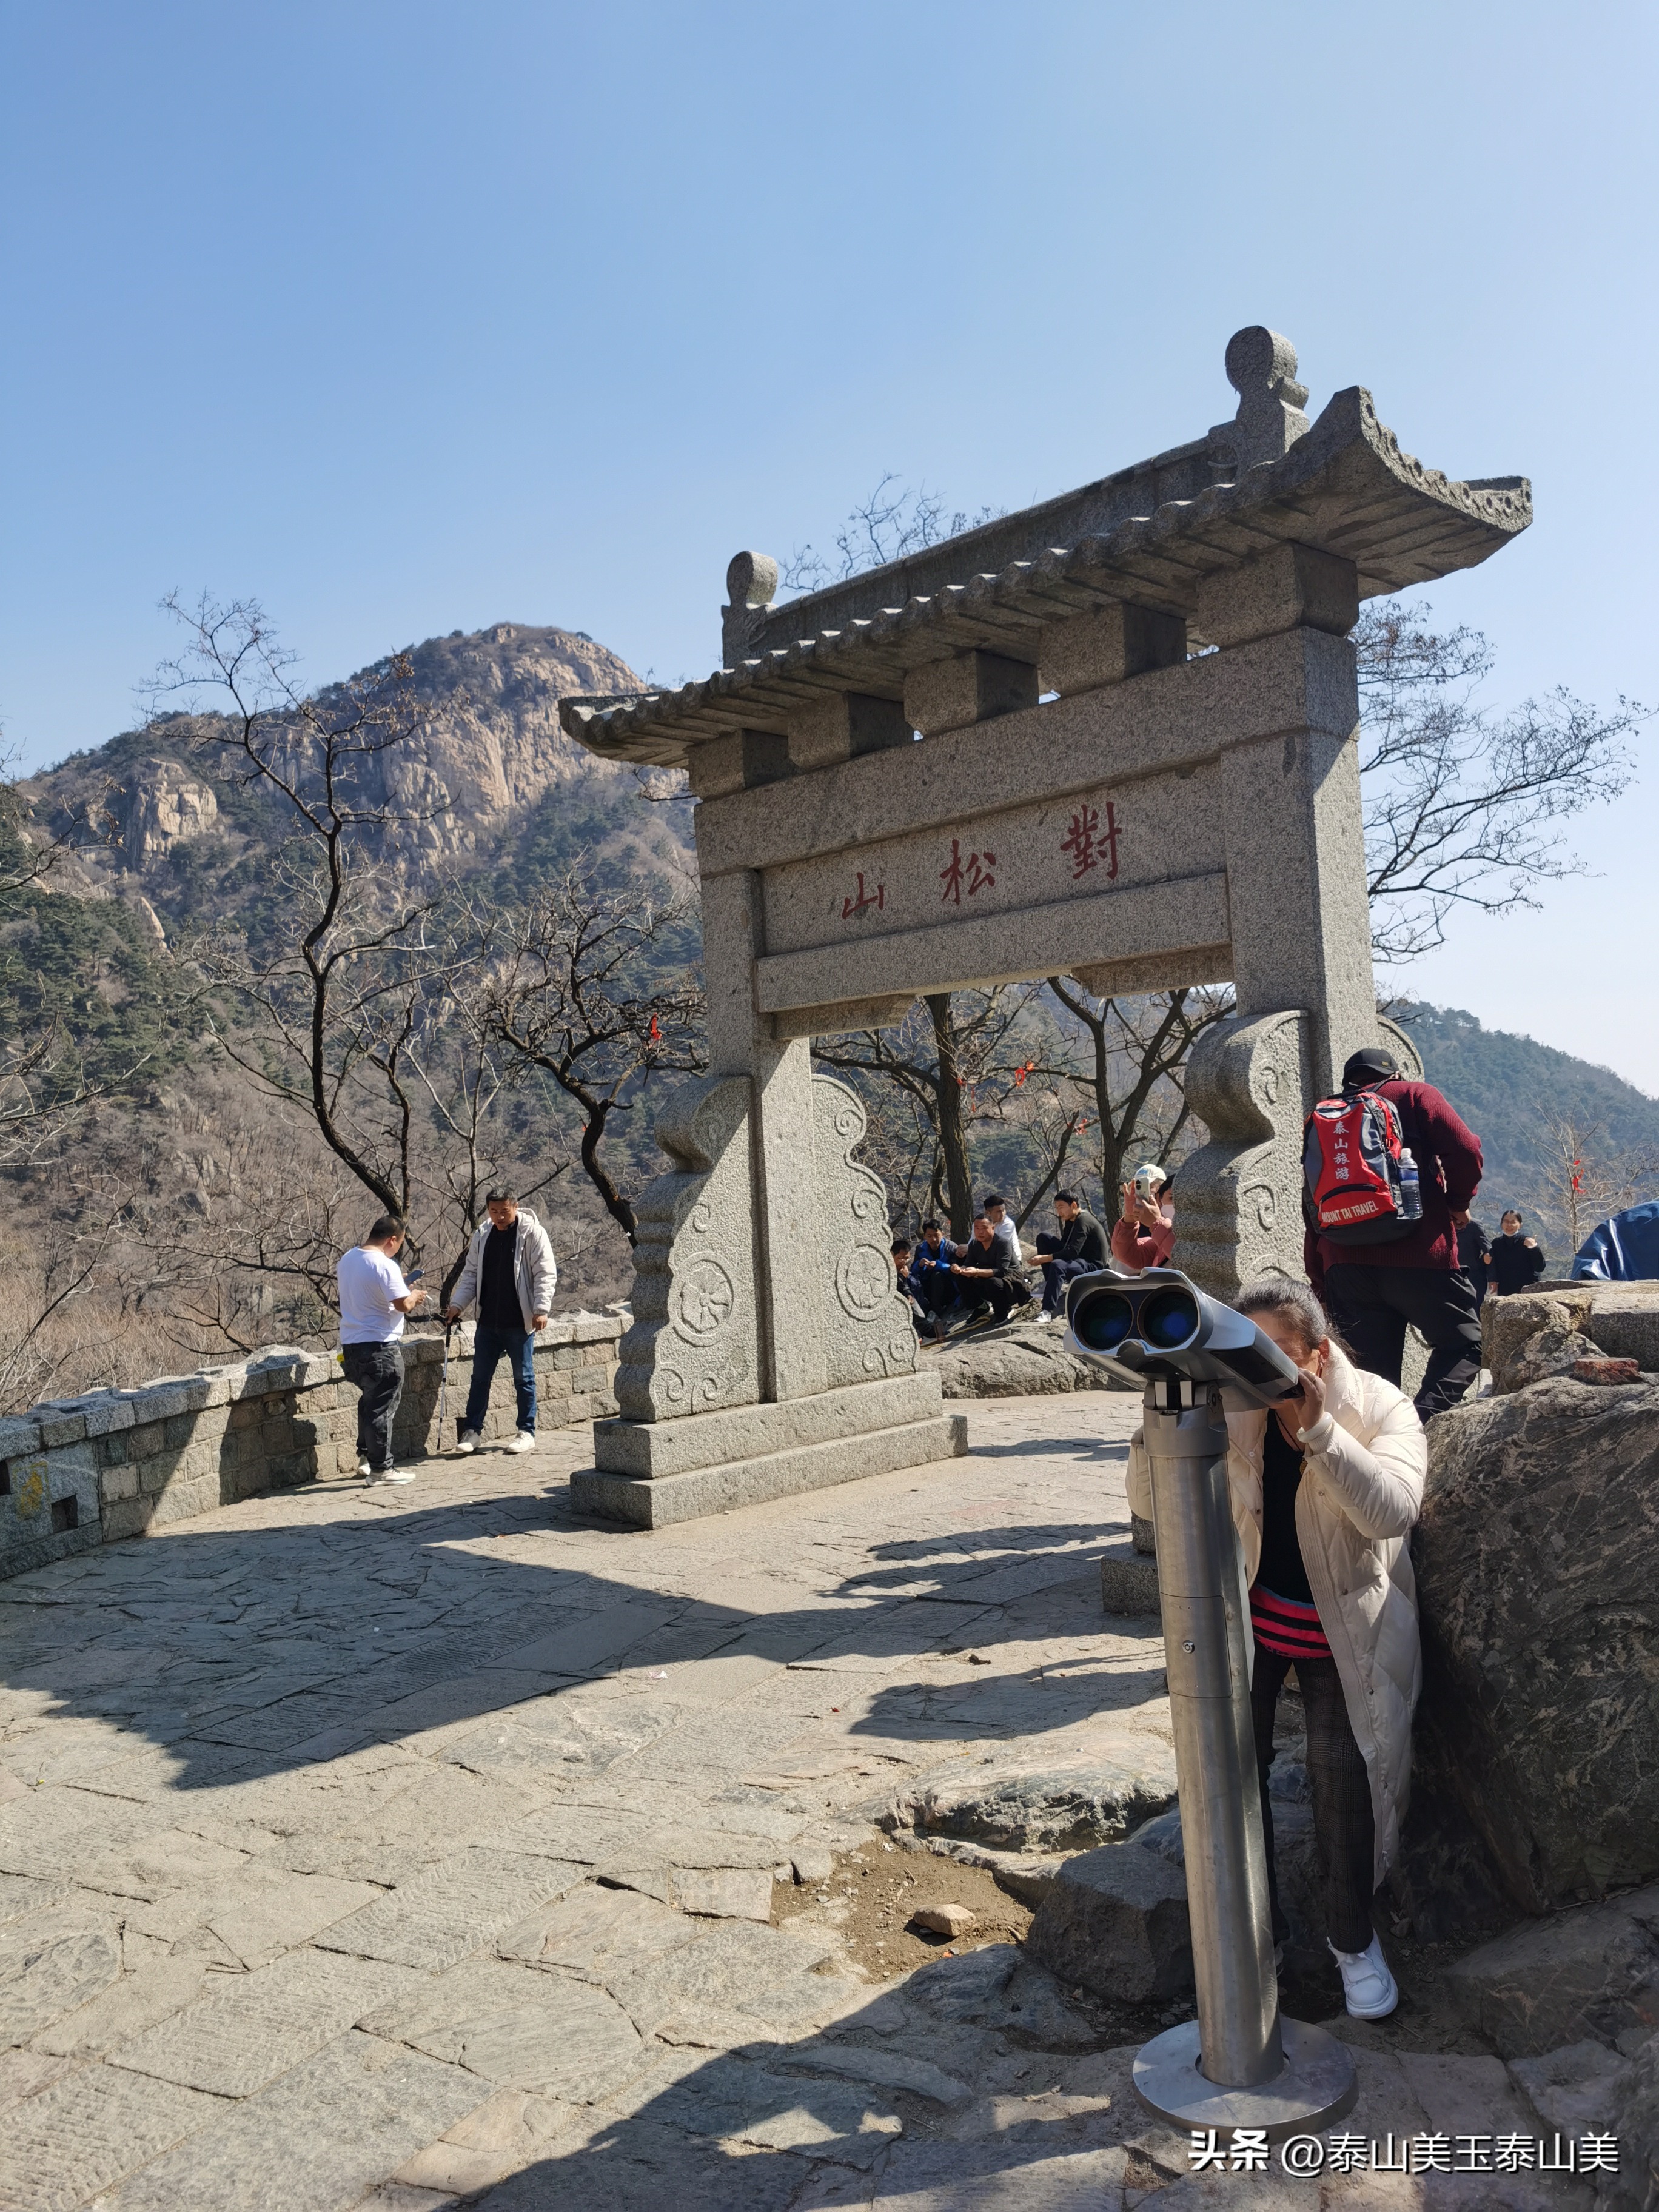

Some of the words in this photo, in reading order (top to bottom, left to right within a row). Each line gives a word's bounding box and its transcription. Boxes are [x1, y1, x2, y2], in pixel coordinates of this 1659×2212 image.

[1333, 1121, 1350, 1180] 泰山旅游
[1321, 1210, 1341, 1223] MOUNT
[1340, 1207, 1353, 1219] TAI
[1350, 1200, 1379, 1217] TRAVEL
